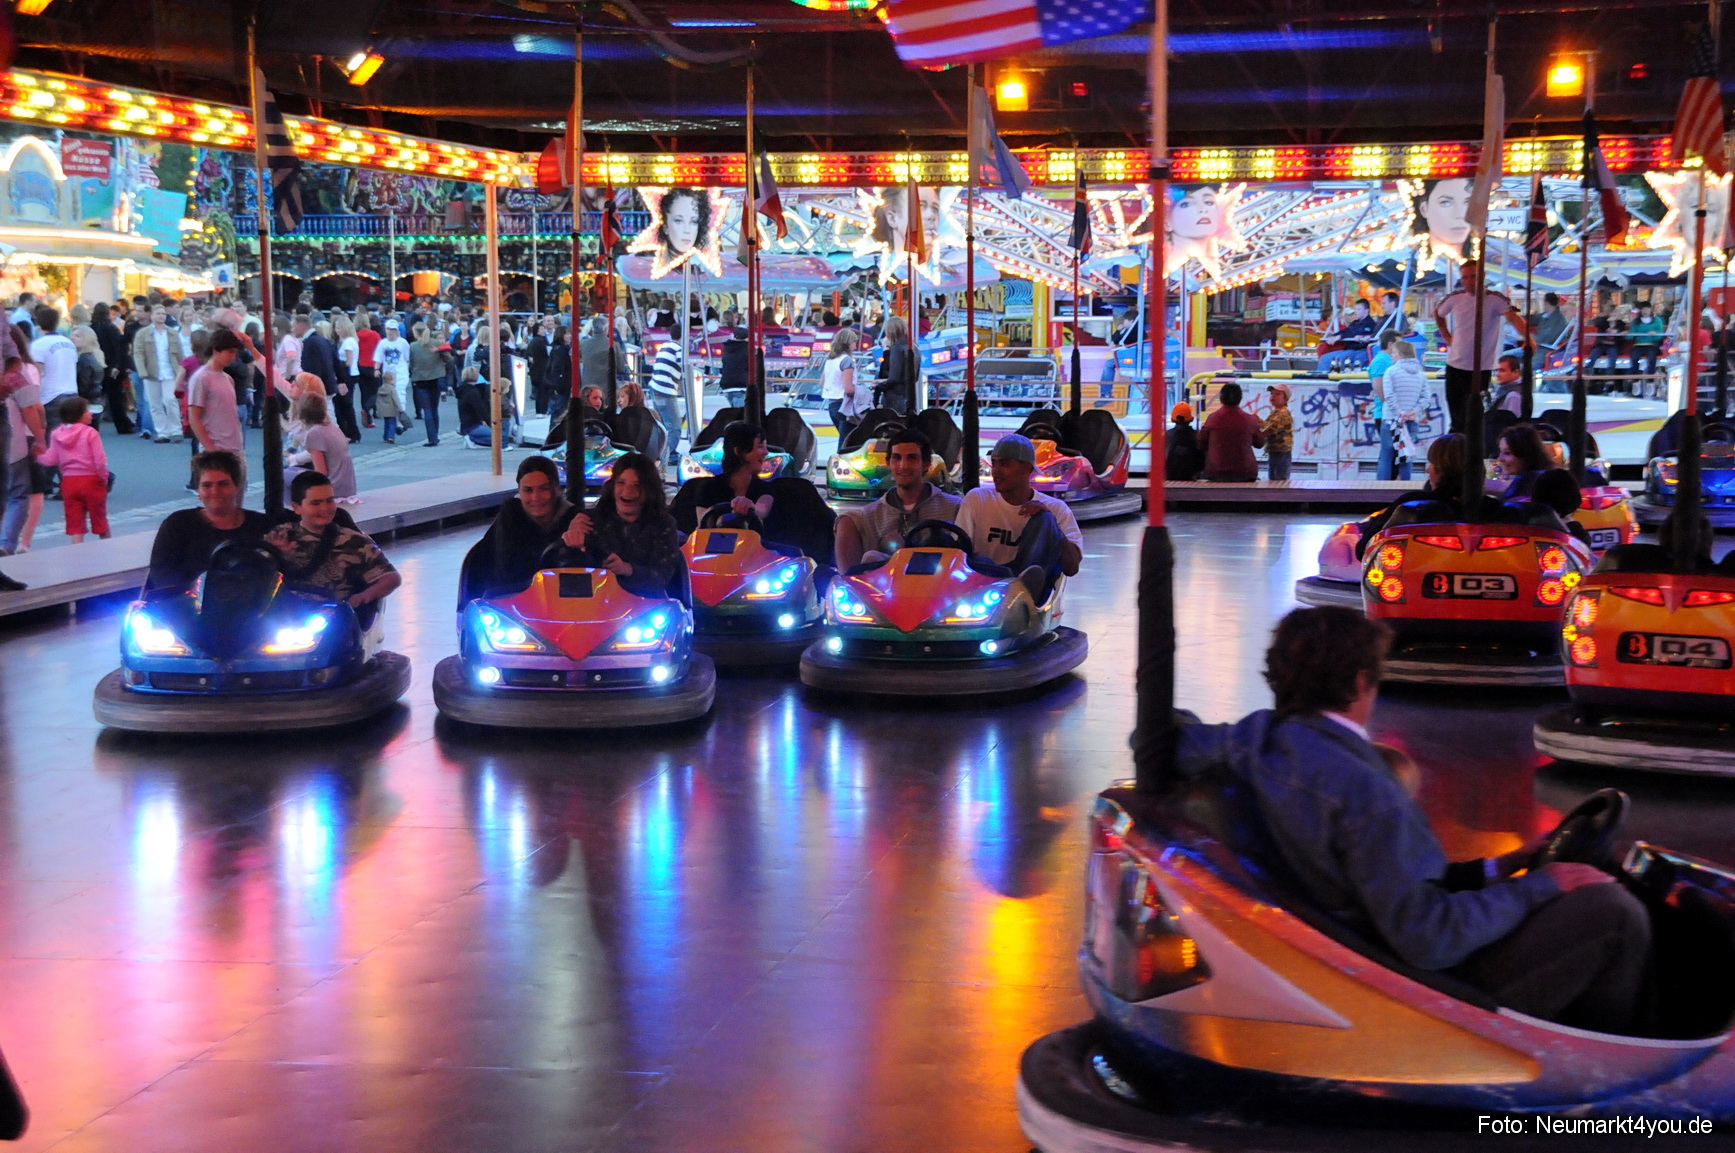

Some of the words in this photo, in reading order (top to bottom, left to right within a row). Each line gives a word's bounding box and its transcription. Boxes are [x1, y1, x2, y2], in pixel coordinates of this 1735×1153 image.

[1506, 215, 1521, 225] WC
[1461, 578, 1505, 591] 03
[1661, 640, 1714, 656] 04
